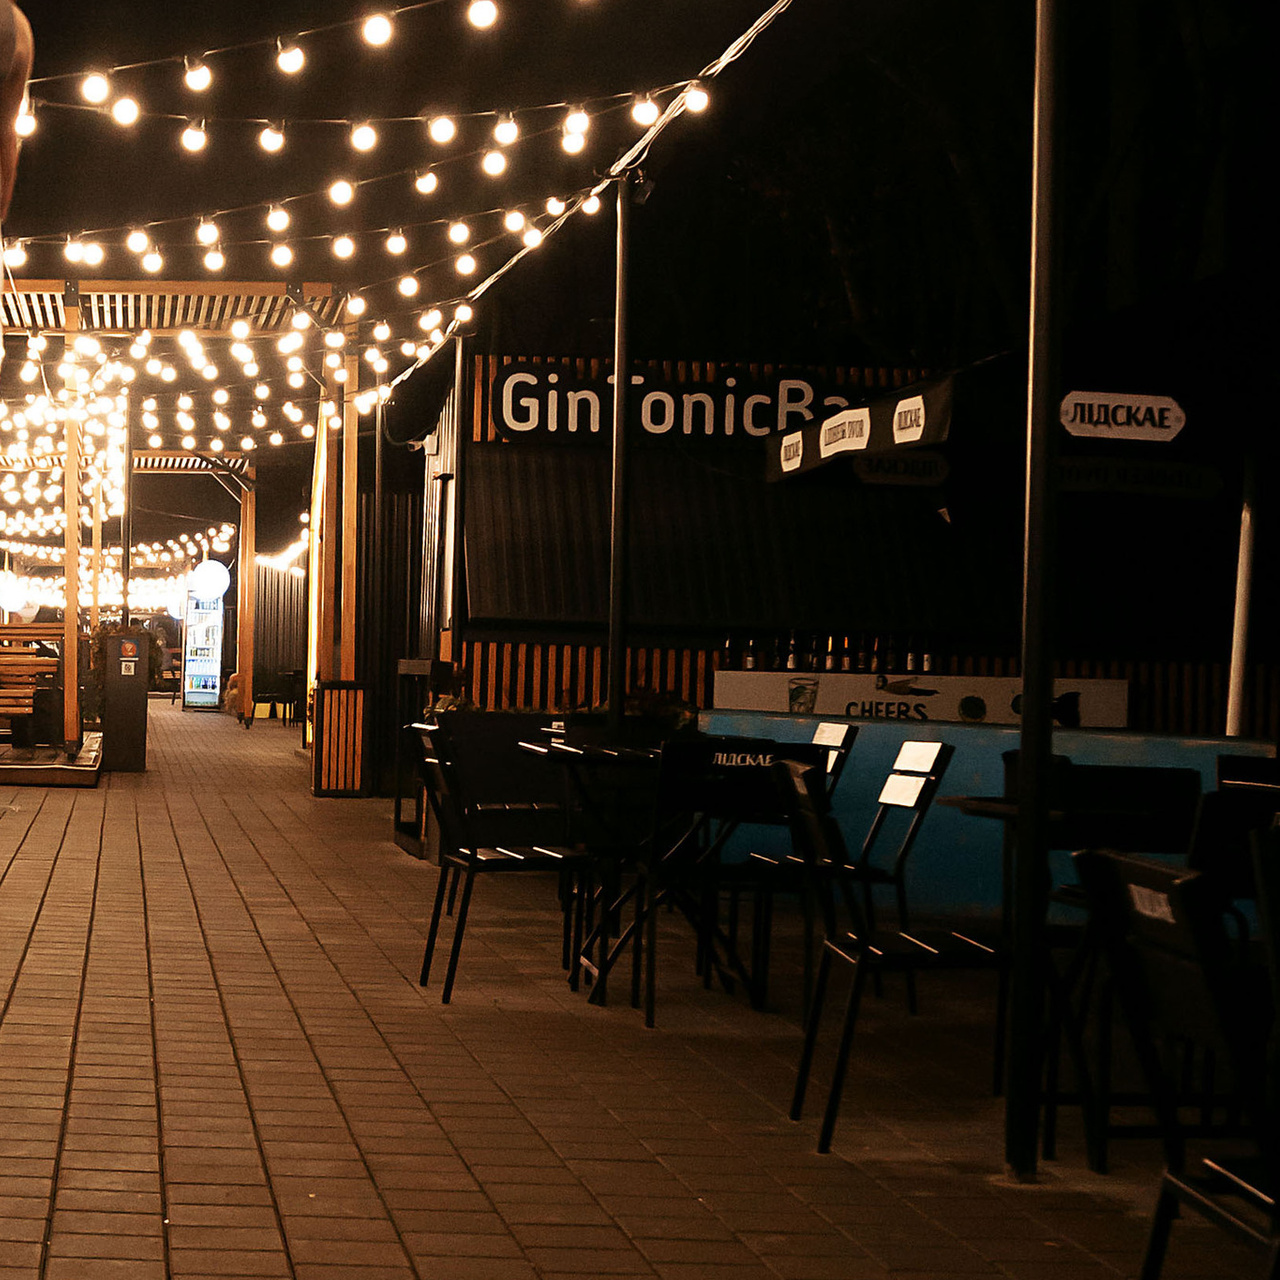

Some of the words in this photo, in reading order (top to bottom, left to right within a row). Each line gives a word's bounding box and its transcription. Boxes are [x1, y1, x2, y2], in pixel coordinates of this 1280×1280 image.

[1070, 402, 1171, 429] ЛІДСКАЕ
[845, 700, 929, 720] CHEERS
[712, 752, 774, 766] ЛІДСКАЕ
